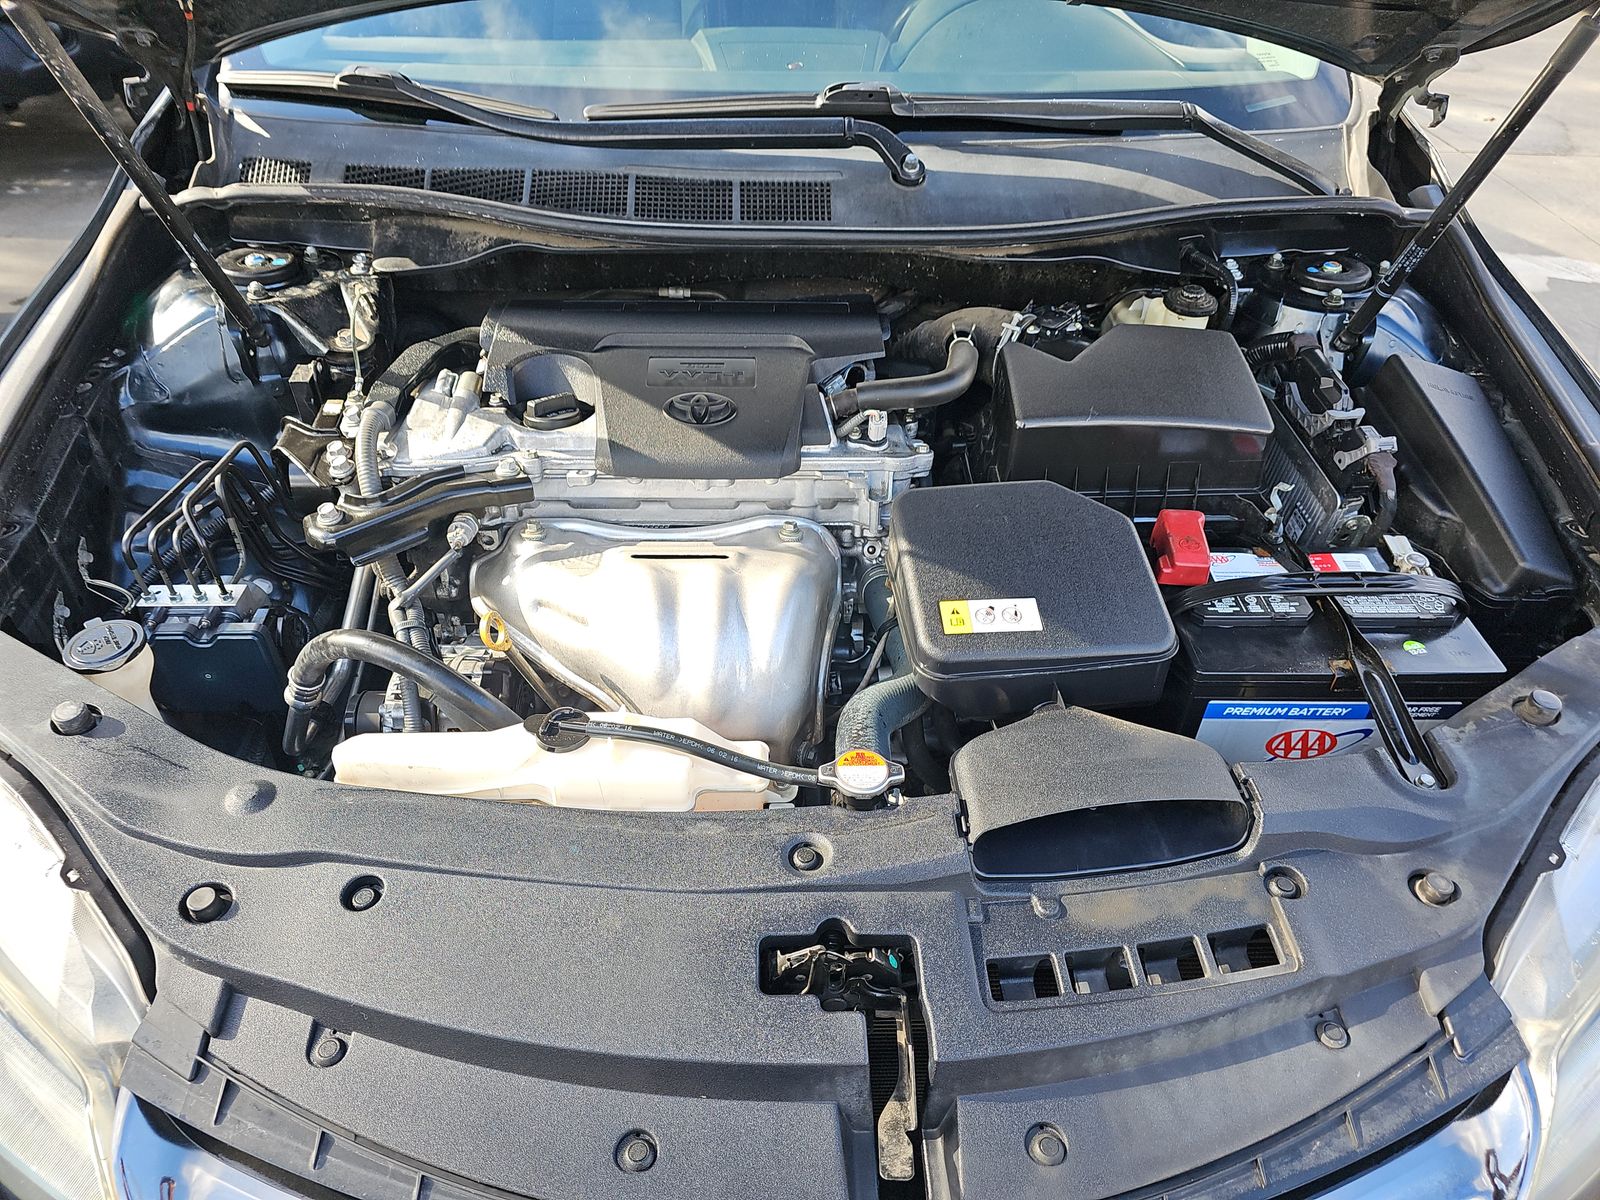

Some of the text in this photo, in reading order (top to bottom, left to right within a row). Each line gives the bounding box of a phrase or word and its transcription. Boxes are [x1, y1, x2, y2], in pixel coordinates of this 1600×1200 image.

[1222, 706, 1352, 717] PREMIUM BATTERY
[652, 730, 676, 741] WATER
[706, 746, 716, 754] 06
[718, 750, 728, 759] 02
[730, 755, 739, 763] 16
[1268, 730, 1333, 759] AAA
[757, 763, 778, 774] WATER
